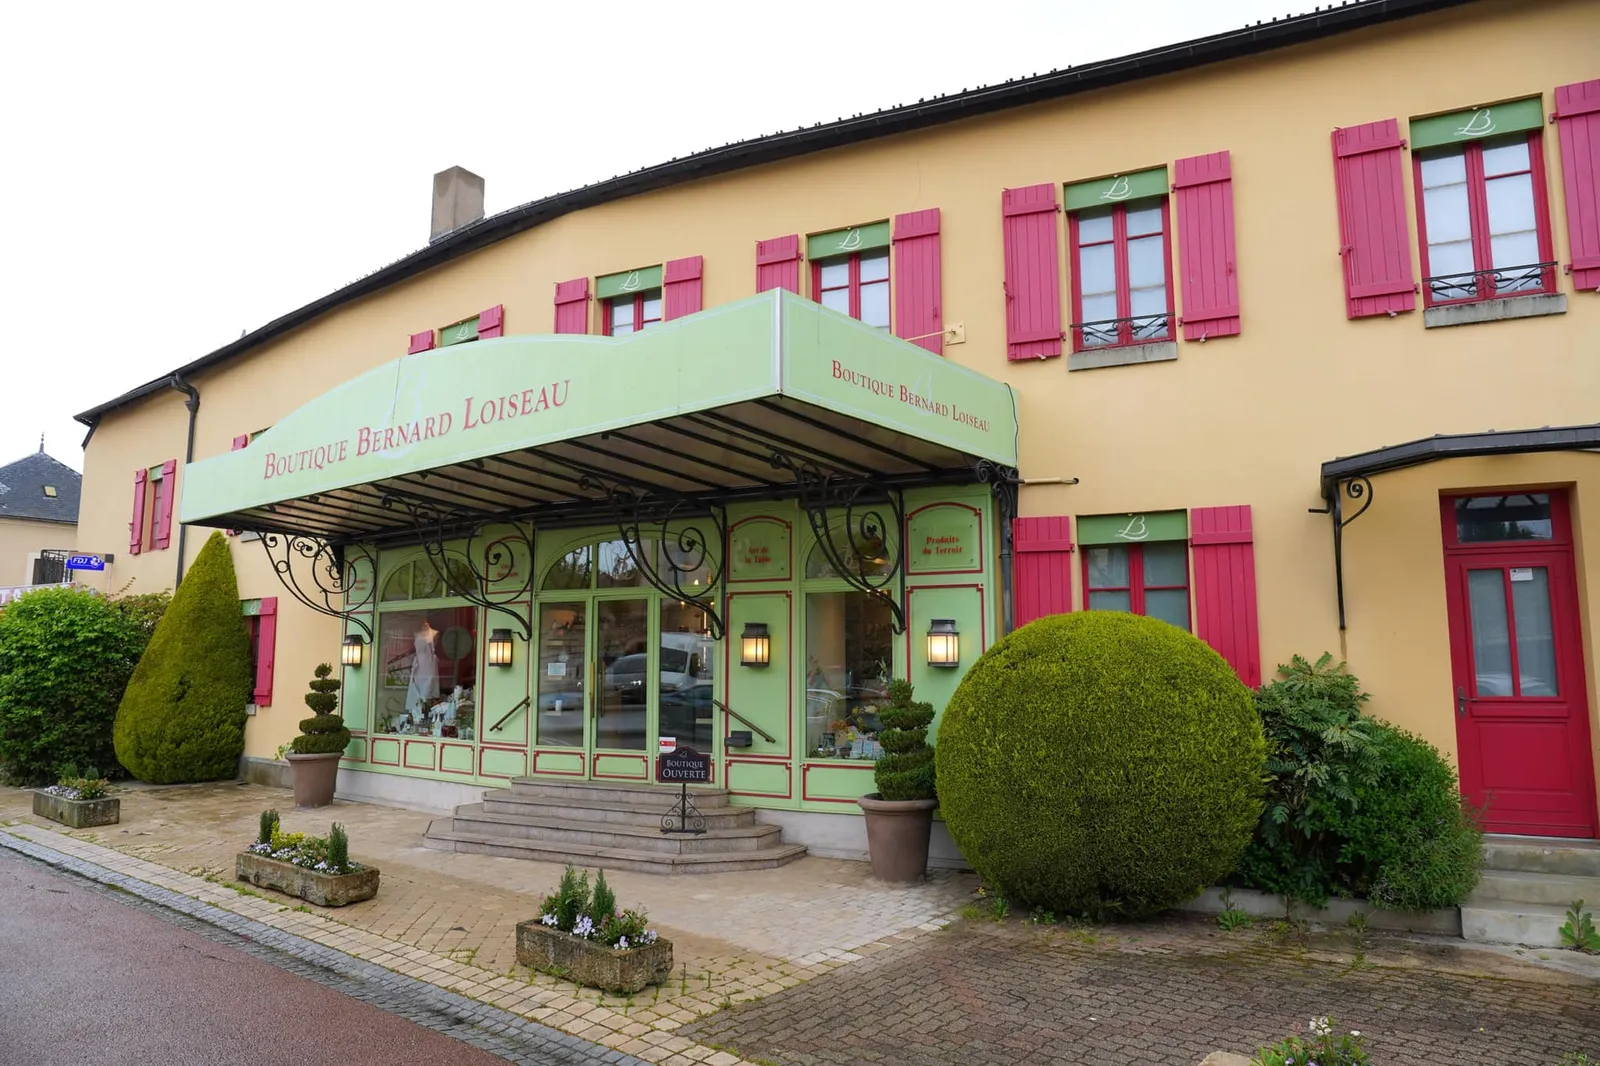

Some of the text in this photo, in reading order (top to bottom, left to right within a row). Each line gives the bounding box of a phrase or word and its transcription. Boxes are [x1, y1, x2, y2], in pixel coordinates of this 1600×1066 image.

[831, 359, 991, 433] BOUTIQUE BERNARD LOISEAU
[264, 379, 570, 480] BOUTIQUE BERNARD LOISEAU
[925, 535, 960, 544] Produits
[922, 545, 963, 555] du Terroir
[666, 759, 704, 769] BOUTIQUE
[662, 768, 706, 779] OUVERTE
